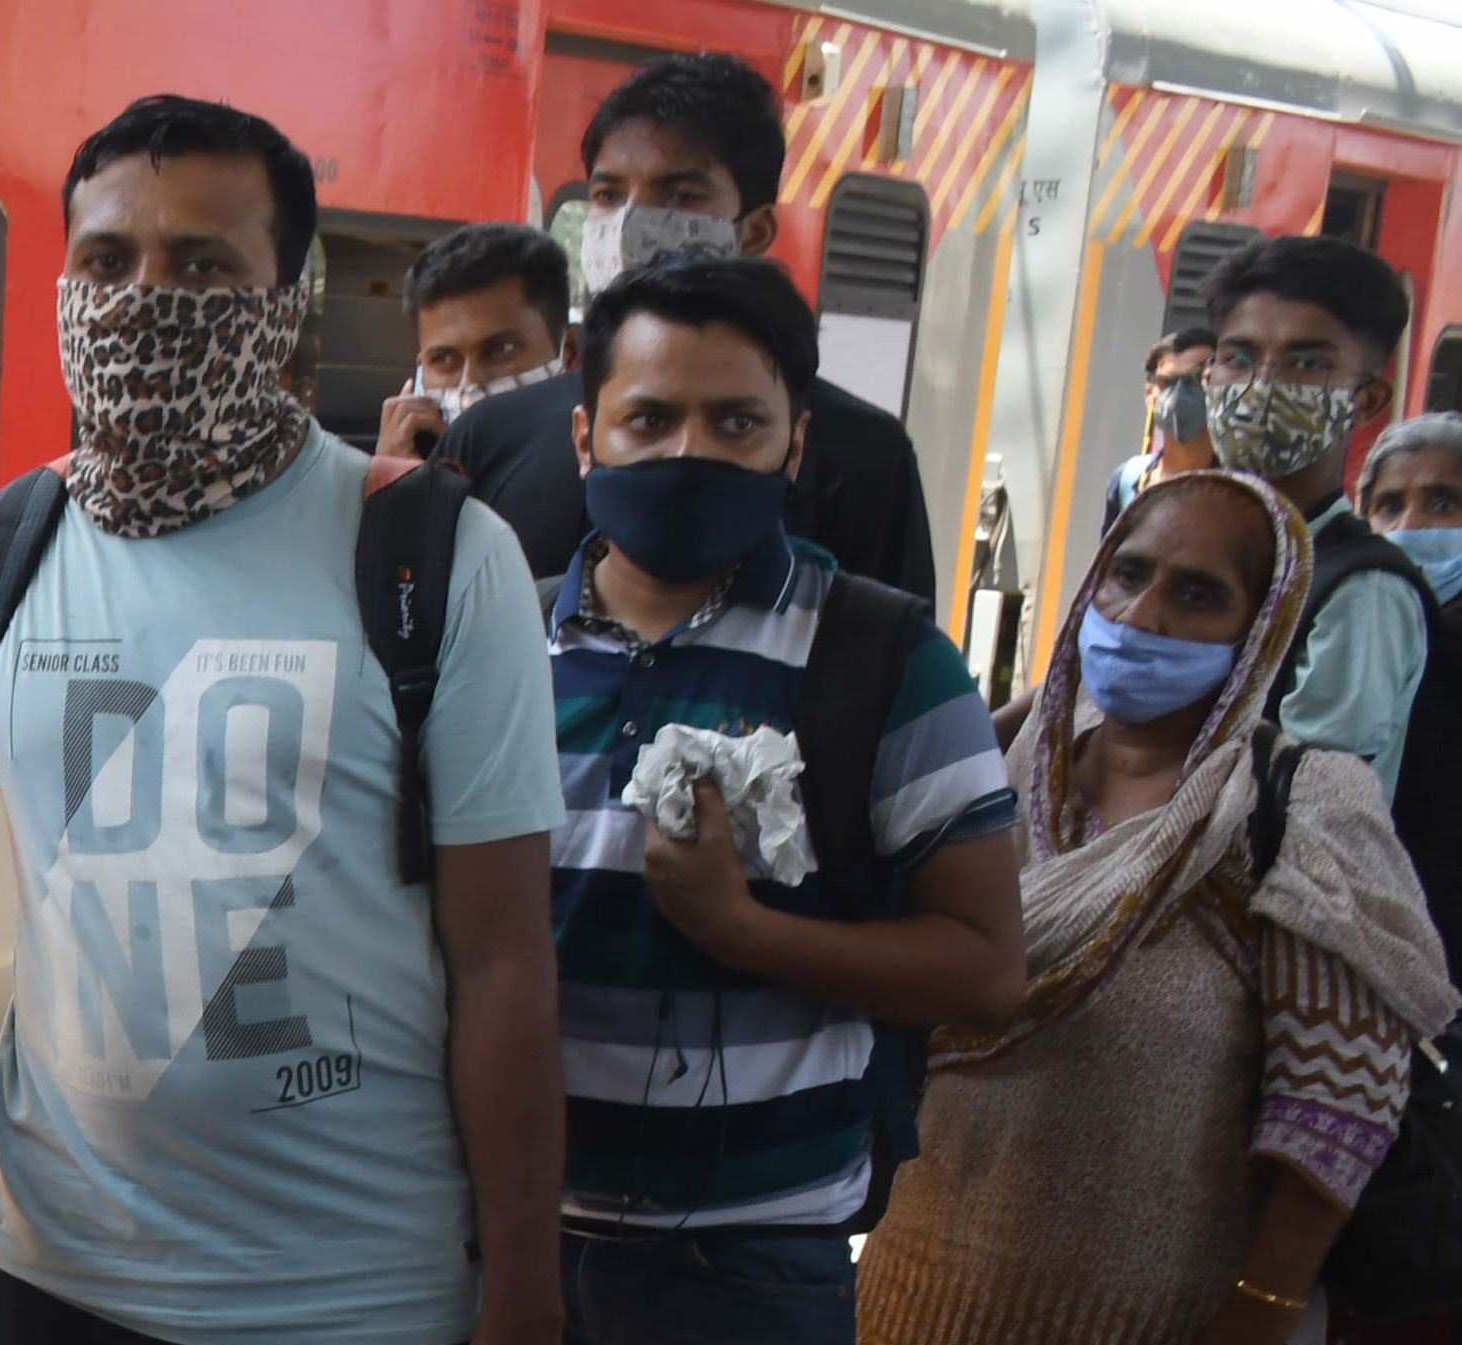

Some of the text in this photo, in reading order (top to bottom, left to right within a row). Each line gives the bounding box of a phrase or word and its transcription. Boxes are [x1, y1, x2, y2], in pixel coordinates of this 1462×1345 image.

[1028, 216, 1041, 236] S
[21, 653, 120, 673] SENIOR CLASS
[196, 652, 306, 673] IT'S BEEN FUN
[63, 675, 304, 857] DO
[70, 873, 313, 1061] NE
[276, 1053, 353, 1103] 2009
